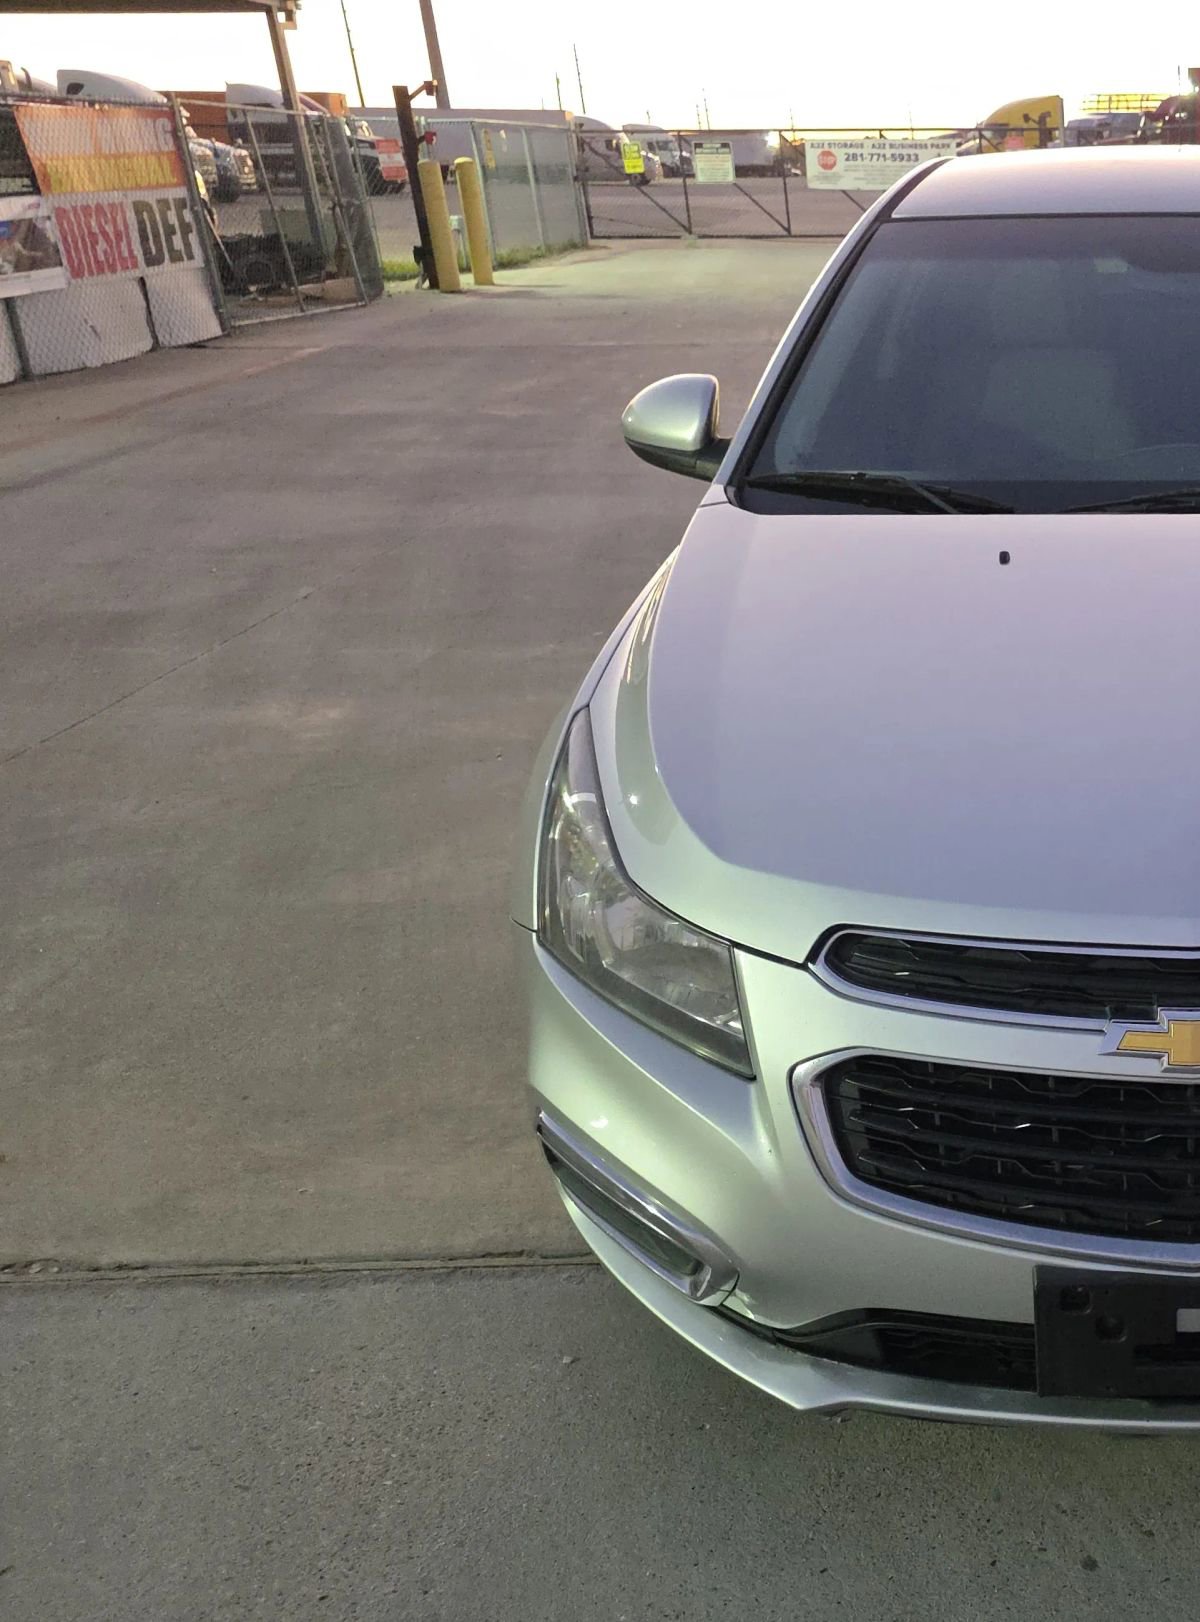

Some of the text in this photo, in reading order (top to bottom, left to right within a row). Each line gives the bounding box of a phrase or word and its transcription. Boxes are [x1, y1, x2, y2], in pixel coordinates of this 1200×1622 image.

[844, 152, 919, 162] 281-771-5933
[55, 197, 195, 279] DIESEL DEF
